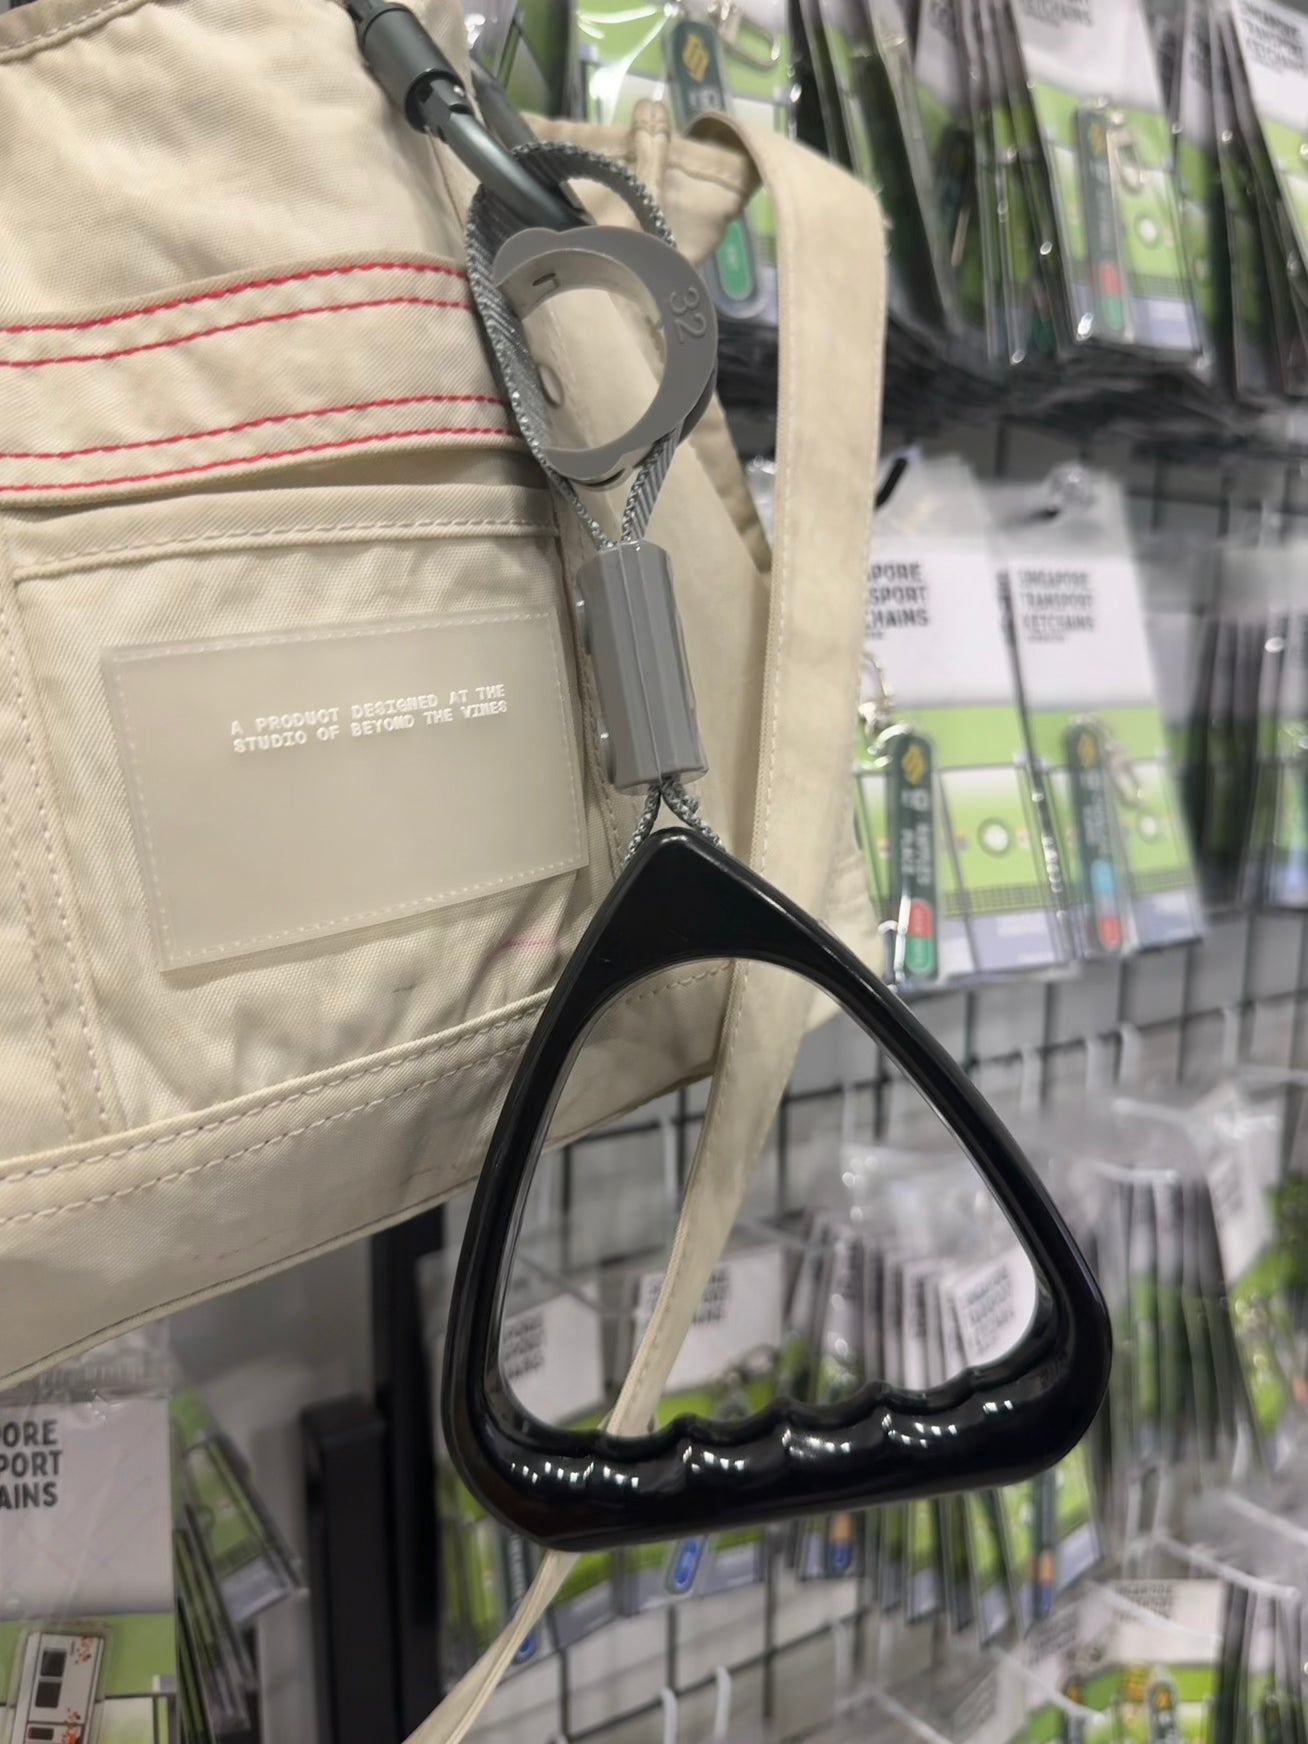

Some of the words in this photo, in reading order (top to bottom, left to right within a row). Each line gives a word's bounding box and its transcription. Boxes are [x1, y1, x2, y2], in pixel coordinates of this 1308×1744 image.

[671, 287, 706, 342] 32
[868, 563, 921, 583] PORE
[866, 609, 929, 630] HAINS
[231, 720, 244, 736] A
[255, 707, 339, 732] PRODUCT
[351, 694, 438, 719] DESIGNED
[449, 689, 468, 704] AT
[475, 684, 505, 701] THE
[233, 730, 307, 753] STUDIO
[316, 725, 340, 741] OF
[350, 714, 415, 737] BEYOND
[424, 708, 453, 724] THE
[460, 700, 507, 718] VINES
[0, 1420, 58, 1448] ORE
